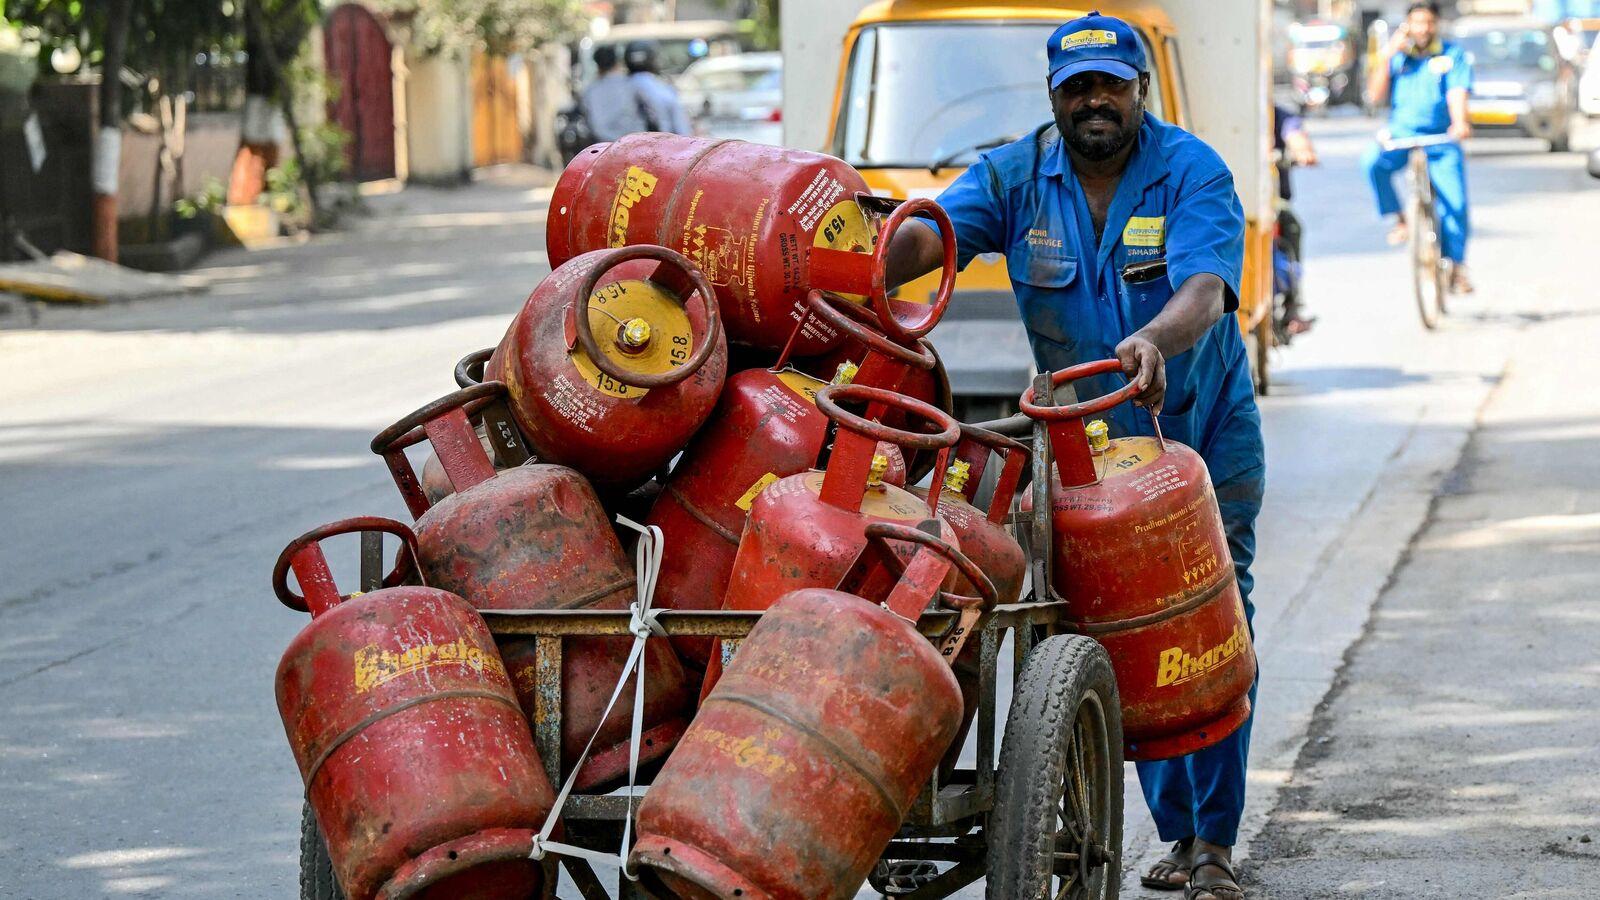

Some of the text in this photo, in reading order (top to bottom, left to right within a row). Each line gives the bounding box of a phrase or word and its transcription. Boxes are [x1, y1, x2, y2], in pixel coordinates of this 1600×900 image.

[753, 198, 769, 231] Pradhan
[797, 202, 809, 215] AND
[682, 232, 690, 245] the
[823, 214, 846, 243] 15.9
[748, 233, 757, 263] Mantri
[670, 335, 688, 367] 15.8
[553, 396, 586, 425] REGULATOR
[558, 408, 570, 419] NOT
[579, 423, 593, 433] USE
[578, 409, 591, 420] OFF
[496, 419, 517, 450] A27
[1116, 454, 1142, 470] 15.7
[1134, 517, 1166, 534] Pradhan
